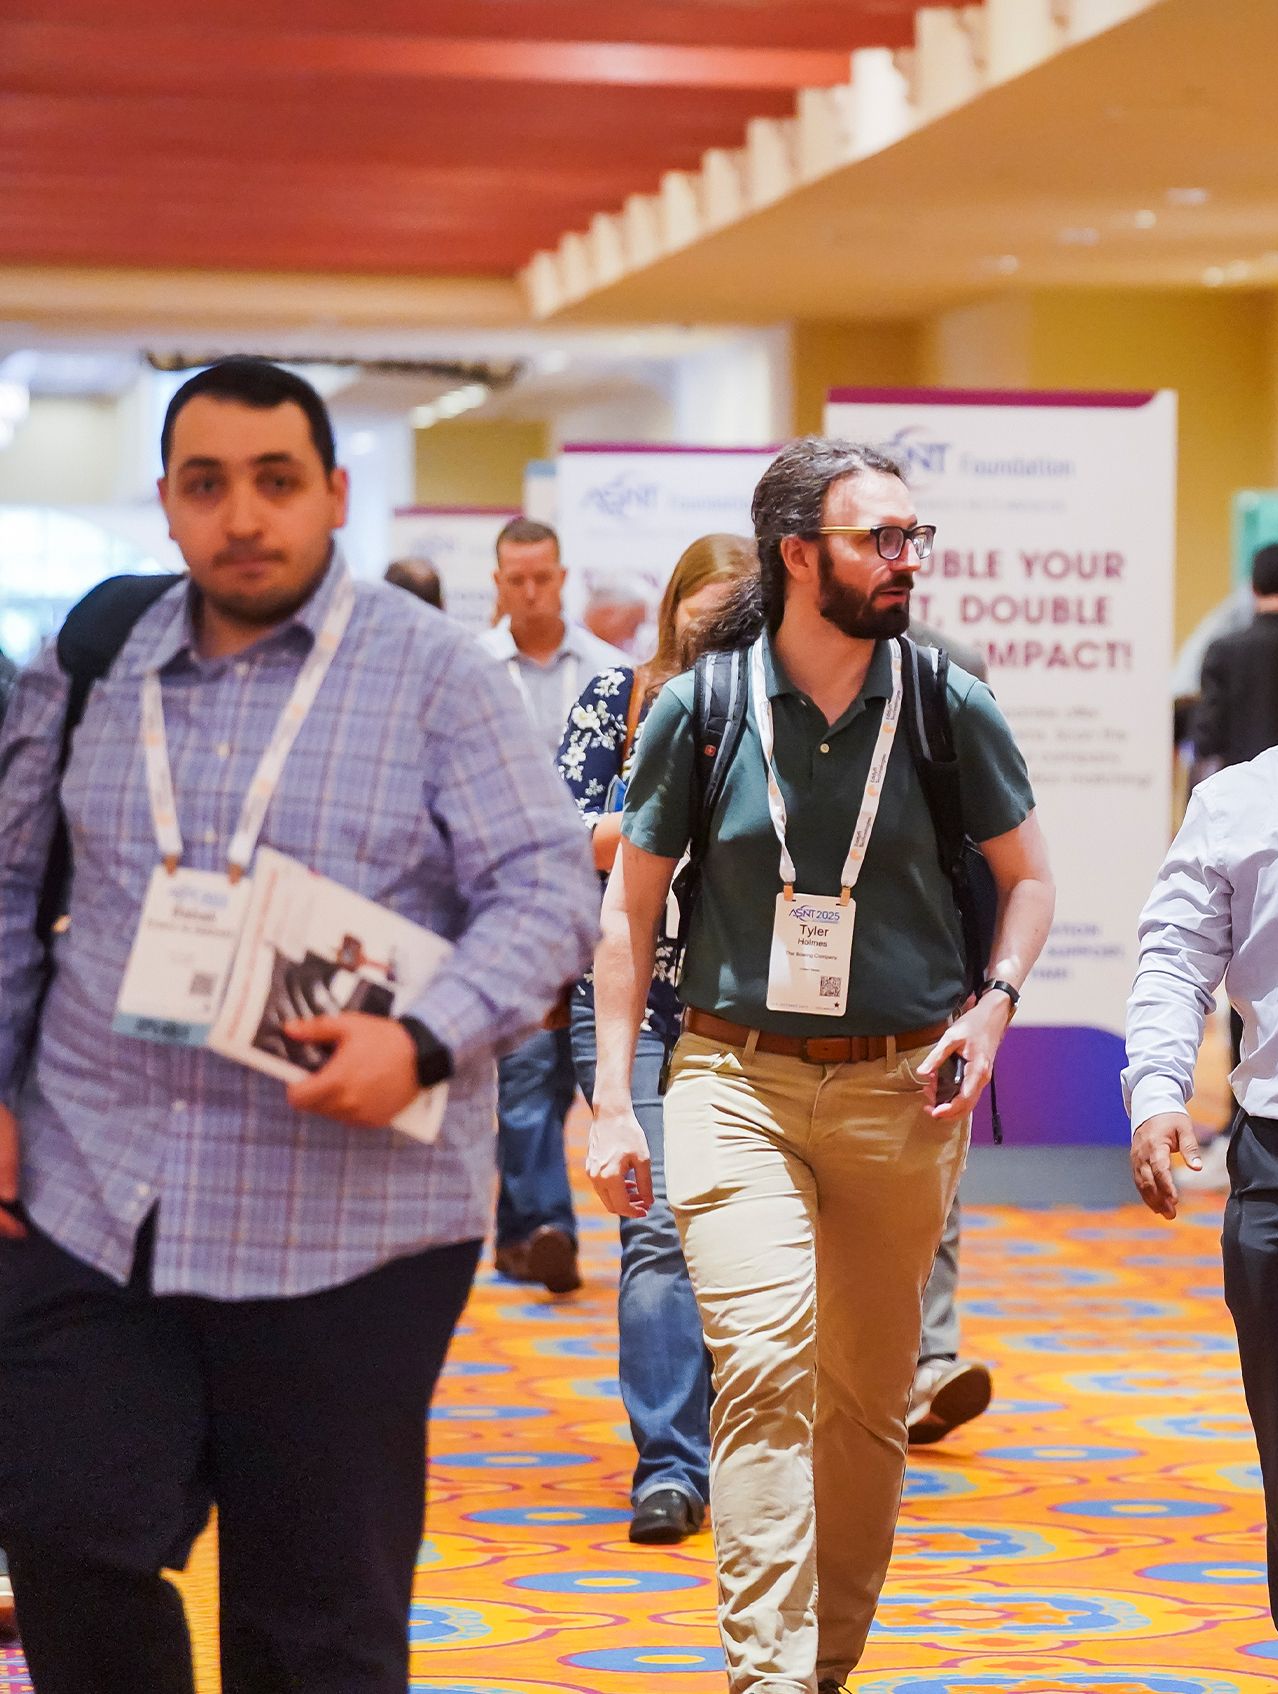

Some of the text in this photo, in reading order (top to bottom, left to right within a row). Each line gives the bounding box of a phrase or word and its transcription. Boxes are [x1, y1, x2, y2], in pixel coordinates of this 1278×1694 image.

[1021, 551, 1125, 579] YOUR
[961, 595, 1110, 624] DOUBLE
[789, 906, 840, 921] ASNT 2025
[800, 924, 829, 938] Tyler
[797, 938, 828, 948] Holmes
